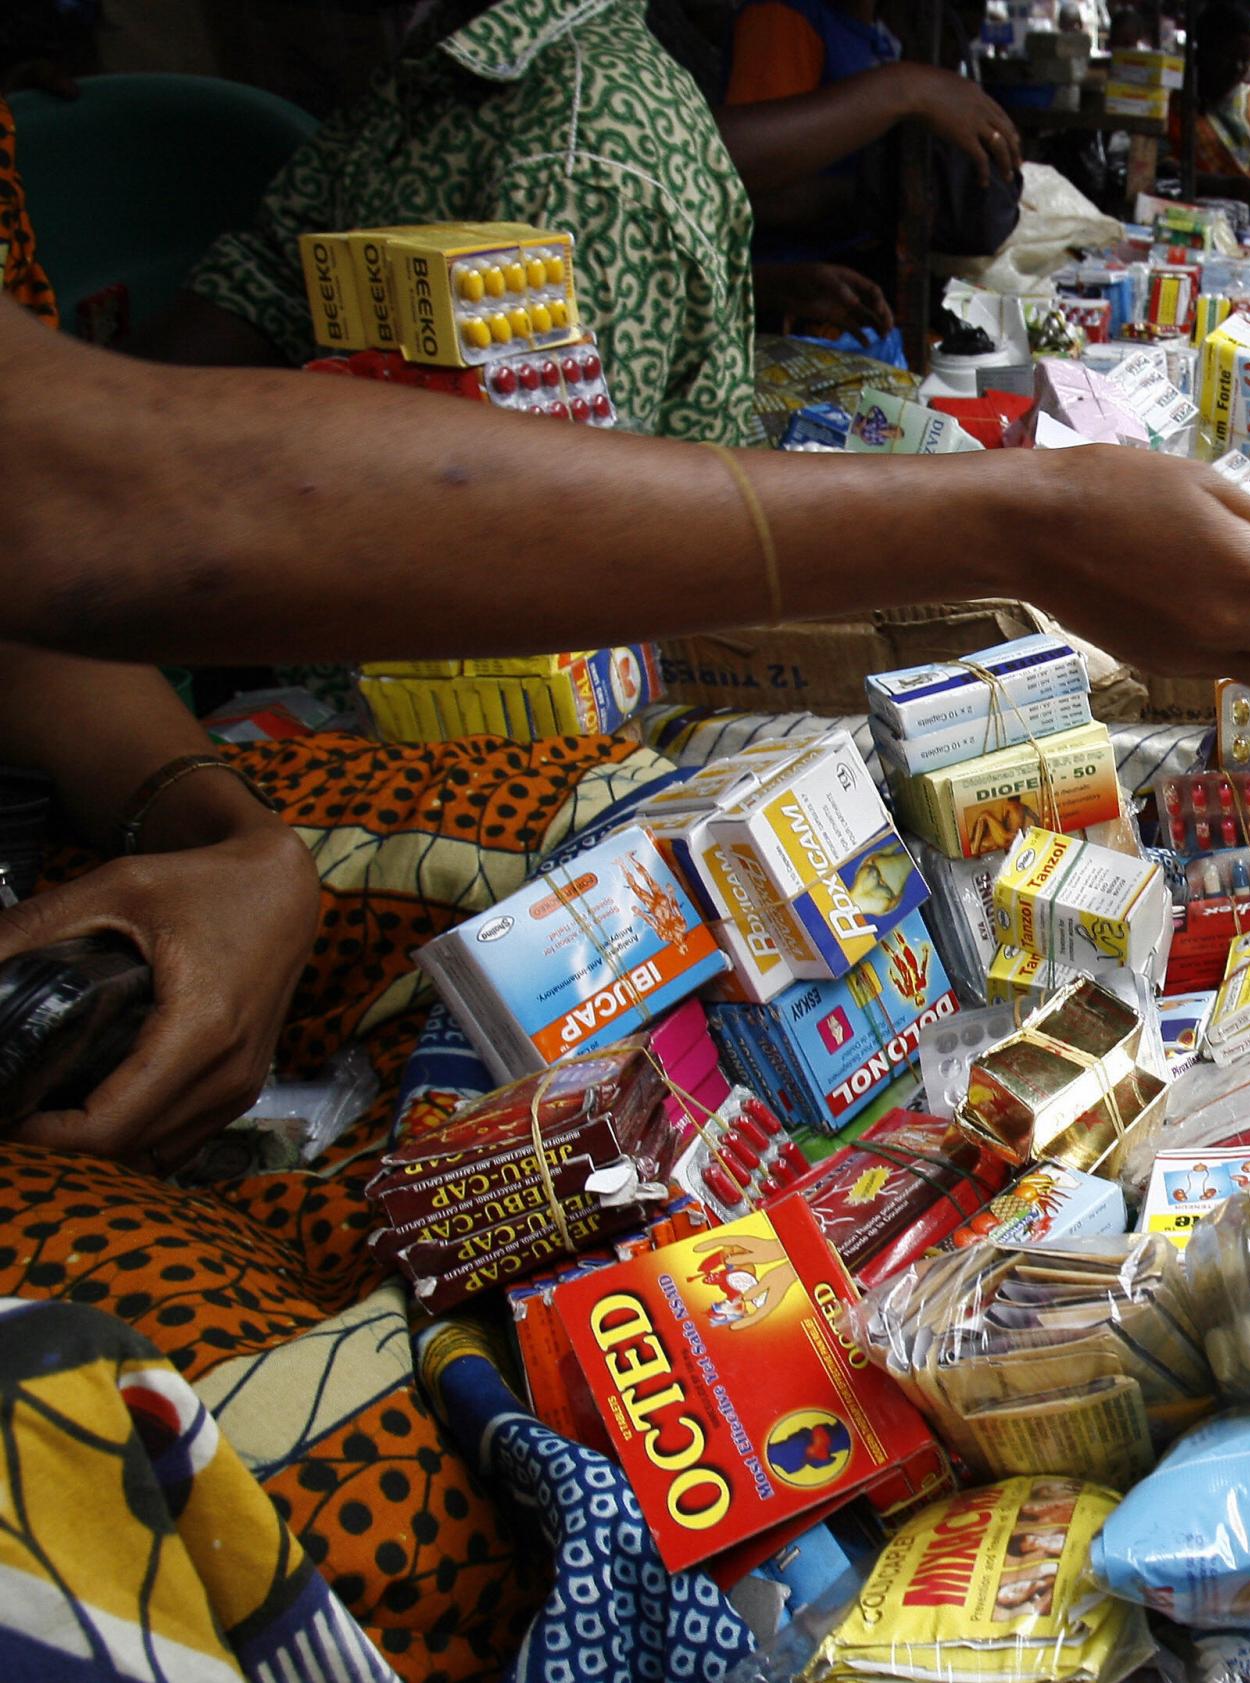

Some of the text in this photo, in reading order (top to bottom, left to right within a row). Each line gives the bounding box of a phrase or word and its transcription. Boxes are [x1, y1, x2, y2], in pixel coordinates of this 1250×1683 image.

[313, 244, 342, 340] BEEKO
[364, 244, 392, 341] BEEKO
[413, 258, 438, 356] BEEKO
[1217, 369, 1231, 411] Forte
[768, 664, 808, 688] 12
[917, 711, 947, 727] Caplets
[920, 744, 951, 760] Caplets
[951, 740, 960, 750] 10
[1073, 764, 1097, 778] 50
[780, 803, 878, 941] ROXICAM
[1027, 840, 1067, 888] Tanzol
[715, 849, 779, 958] ROXICAM
[1018, 899, 1033, 953] Tanzol
[1019, 953, 1040, 977] Tan
[559, 963, 663, 1044] IBUCAP
[785, 987, 825, 1023] ESKAY
[427, 1143, 577, 1210] JEBU-CAP
[466, 1213, 599, 1292] JEBU-CAP
[867, 1227, 878, 1238] de
[655, 1271, 775, 1501] Most Effective Yet Safe NSAID
[590, 1294, 731, 1530] OCTED
[607, 1394, 634, 1441] 12 TABLETS
